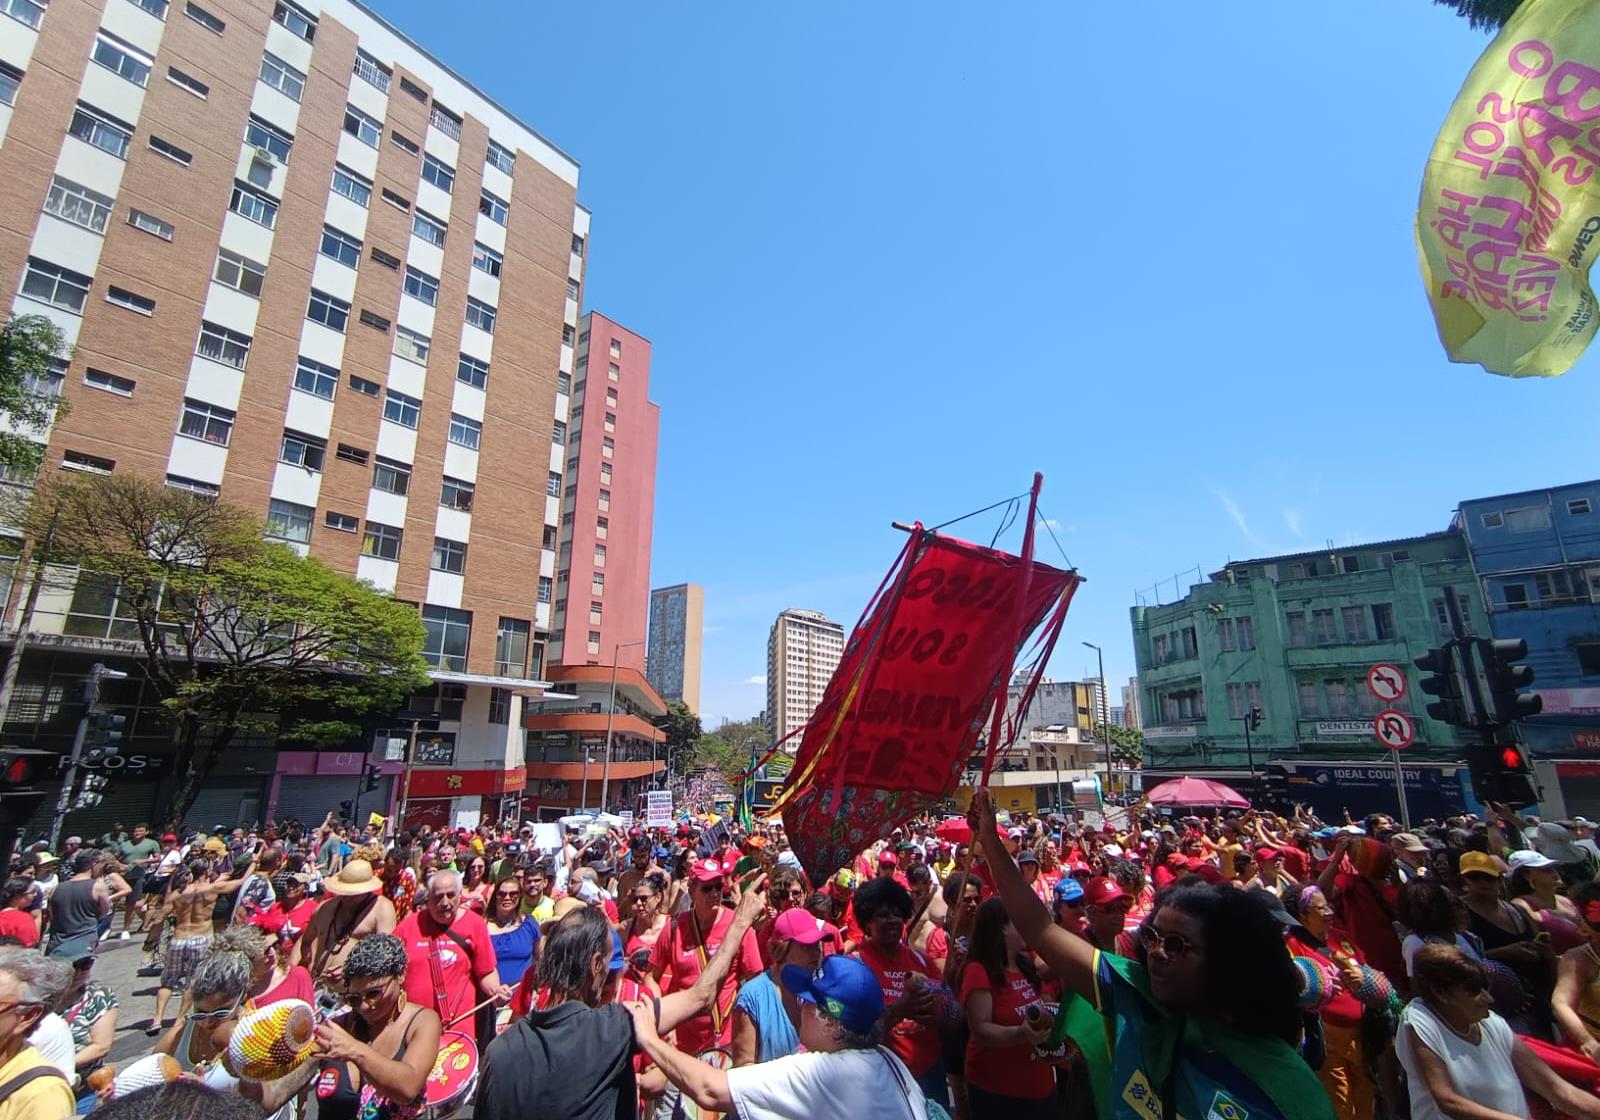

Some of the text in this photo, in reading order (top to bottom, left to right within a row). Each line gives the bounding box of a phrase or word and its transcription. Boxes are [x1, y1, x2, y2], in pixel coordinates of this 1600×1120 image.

[1319, 721, 1377, 731] DENTISTA
[1333, 768, 1422, 780] IDEAL COUNTRY
